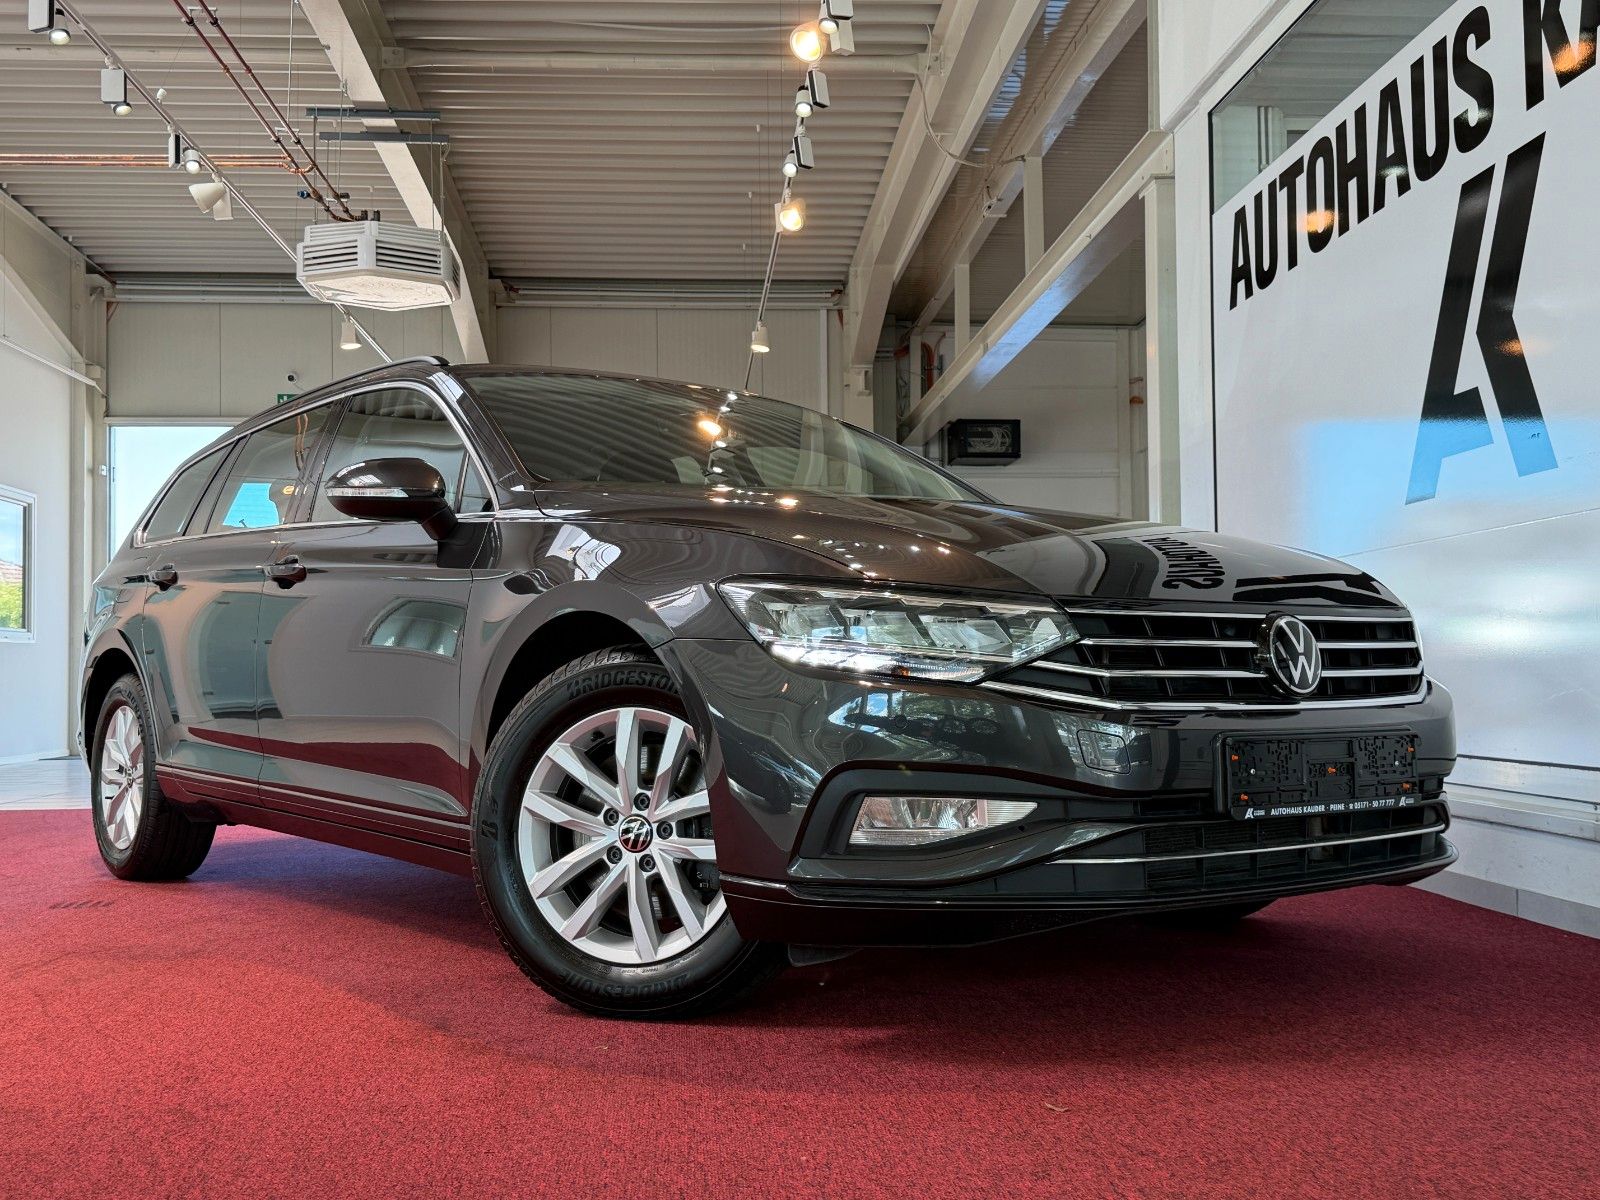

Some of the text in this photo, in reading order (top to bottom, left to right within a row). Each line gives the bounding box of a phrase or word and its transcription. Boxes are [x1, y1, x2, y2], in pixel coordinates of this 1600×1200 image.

[1229, 5, 1495, 311] AUTOHAUS
[567, 669, 681, 700] BRIDGESTO
[1271, 806, 1303, 816] AUTOHAUS
[1303, 804, 1326, 814] KAUDER
[1329, 803, 1345, 811] PEINE
